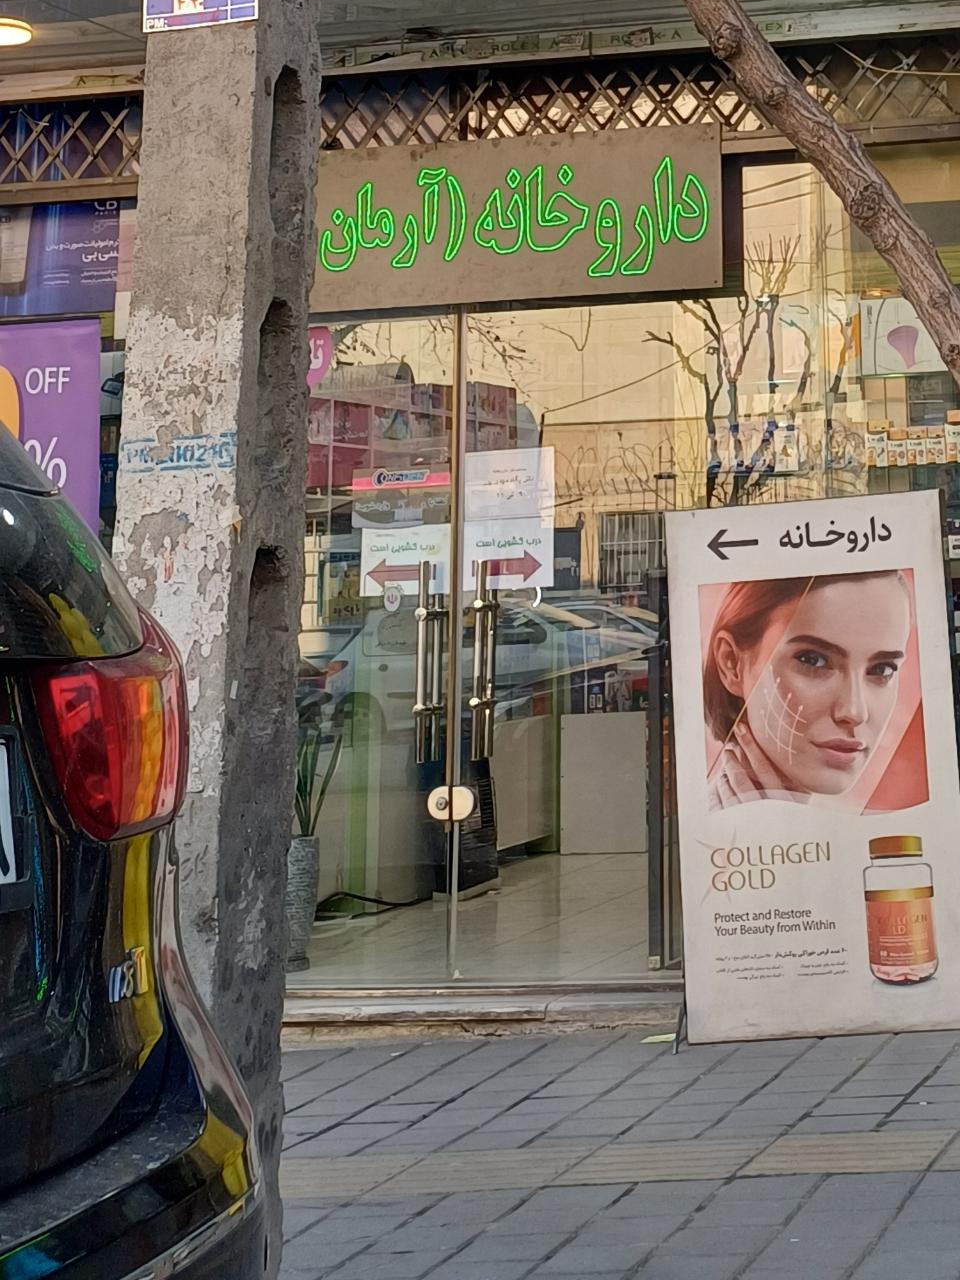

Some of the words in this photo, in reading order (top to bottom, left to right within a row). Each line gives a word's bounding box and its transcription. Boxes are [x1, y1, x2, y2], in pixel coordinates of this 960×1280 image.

[473, 155, 710, 278] داروخانه
[24, 366, 71, 395] OFF
[778, 515, 893, 555] داروخانه
[710, 841, 831, 869] COLLAGEN
[711, 868, 776, 892] GOLD
[714, 911, 750, 923] Protect
[752, 909, 772, 921] and
[774, 907, 812, 920] Restore
[714, 925, 738, 937] Your
[740, 923, 775, 936] Beauty
[777, 921, 801, 933] from
[801, 919, 836, 931] Within
